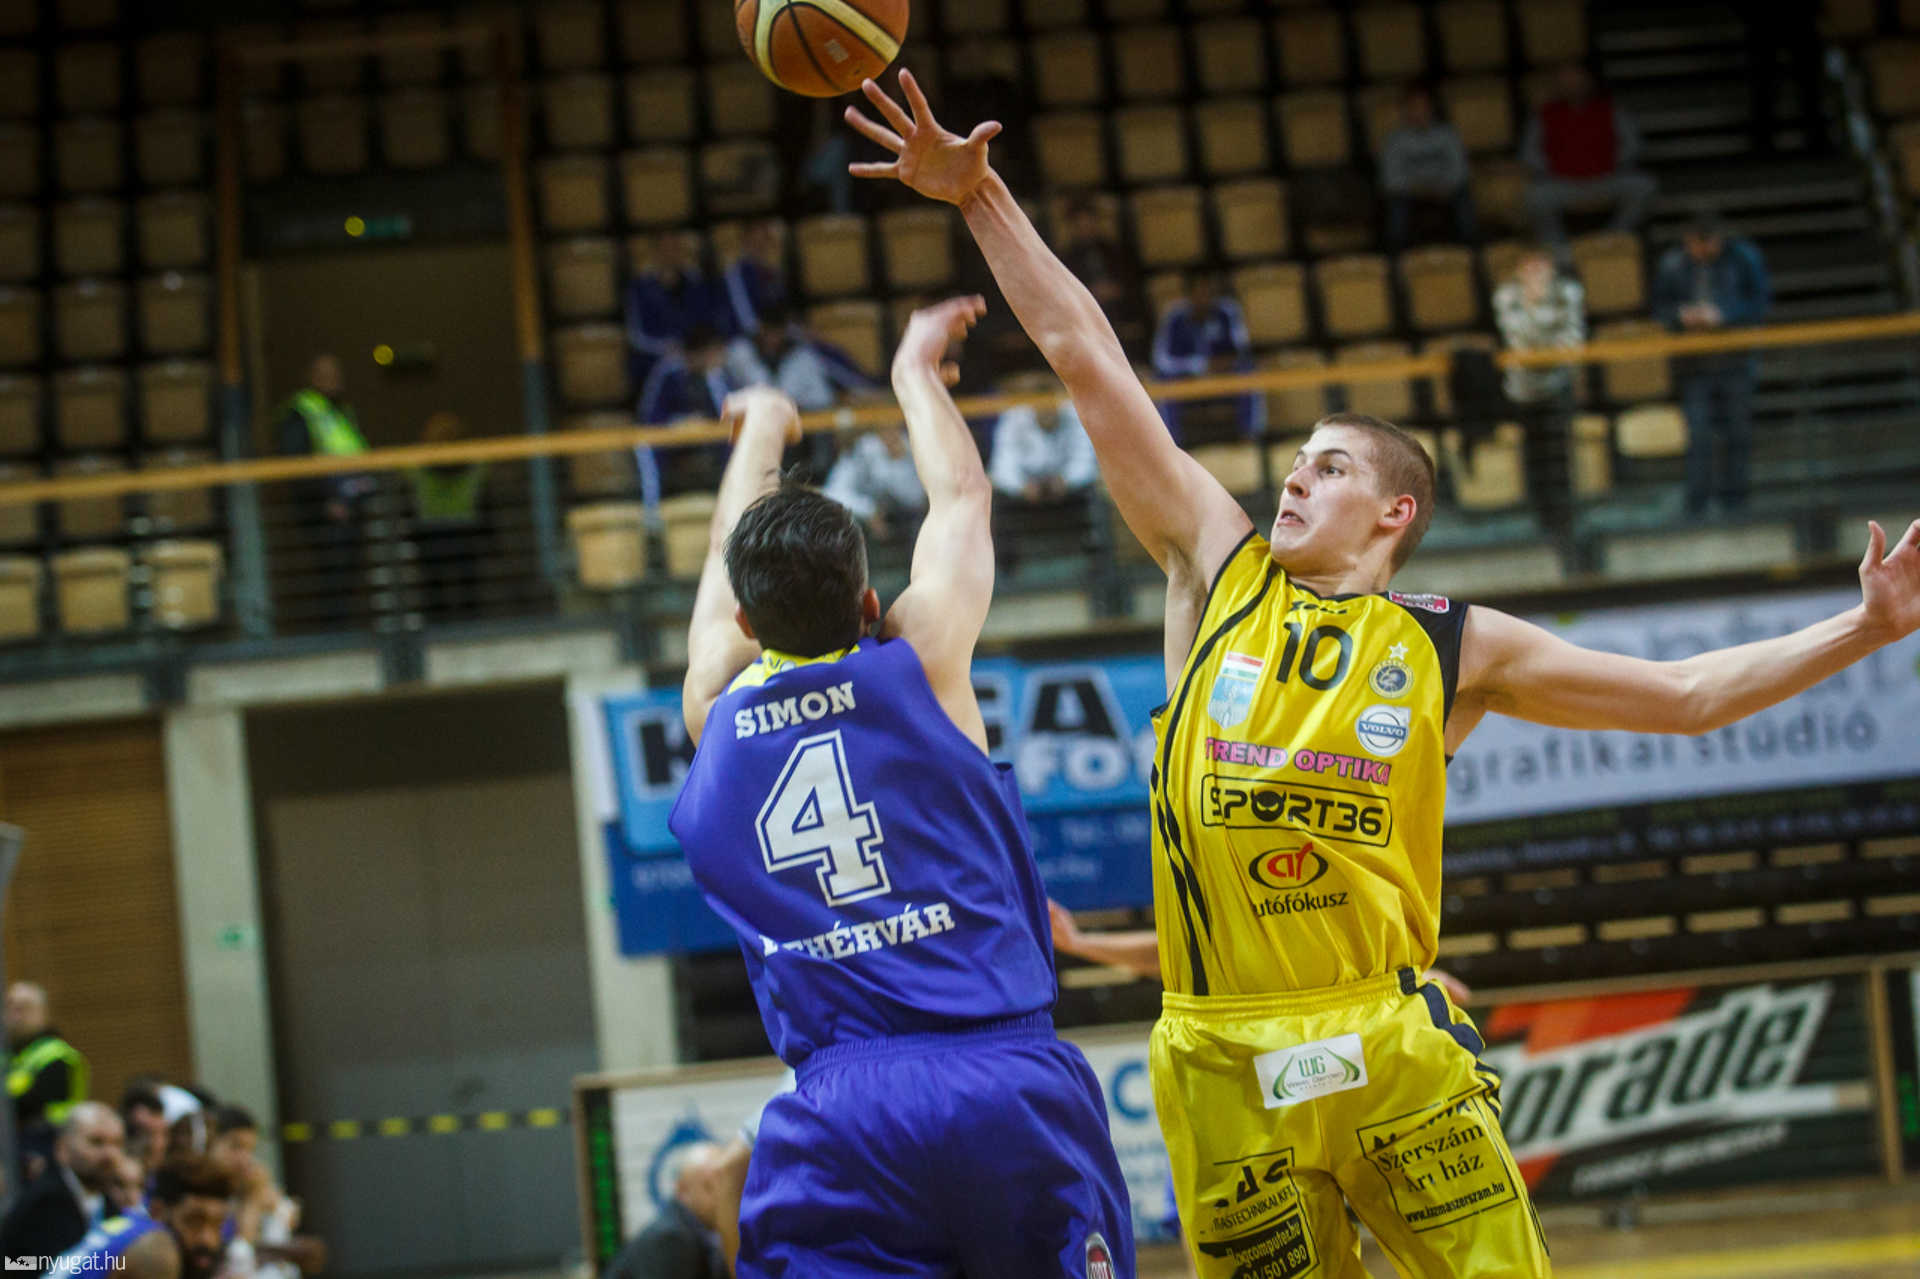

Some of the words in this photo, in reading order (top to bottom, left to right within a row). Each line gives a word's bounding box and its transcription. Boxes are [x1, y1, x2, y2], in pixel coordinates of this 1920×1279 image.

[1276, 622, 1354, 691] 10
[734, 681, 857, 739] SIMON
[1361, 722, 1405, 738] VOLVO
[1205, 736, 1288, 769] TREND
[1294, 749, 1392, 786] OPTIKA
[1447, 731, 1677, 797] grafikai
[754, 728, 892, 908] 4
[1252, 892, 1350, 918] utófókusz
[1498, 1002, 1808, 1145] orade
[1376, 1124, 1485, 1173] Szerszám
[1438, 1153, 1485, 1182] ház
[1286, 1243, 1308, 1269] 890
